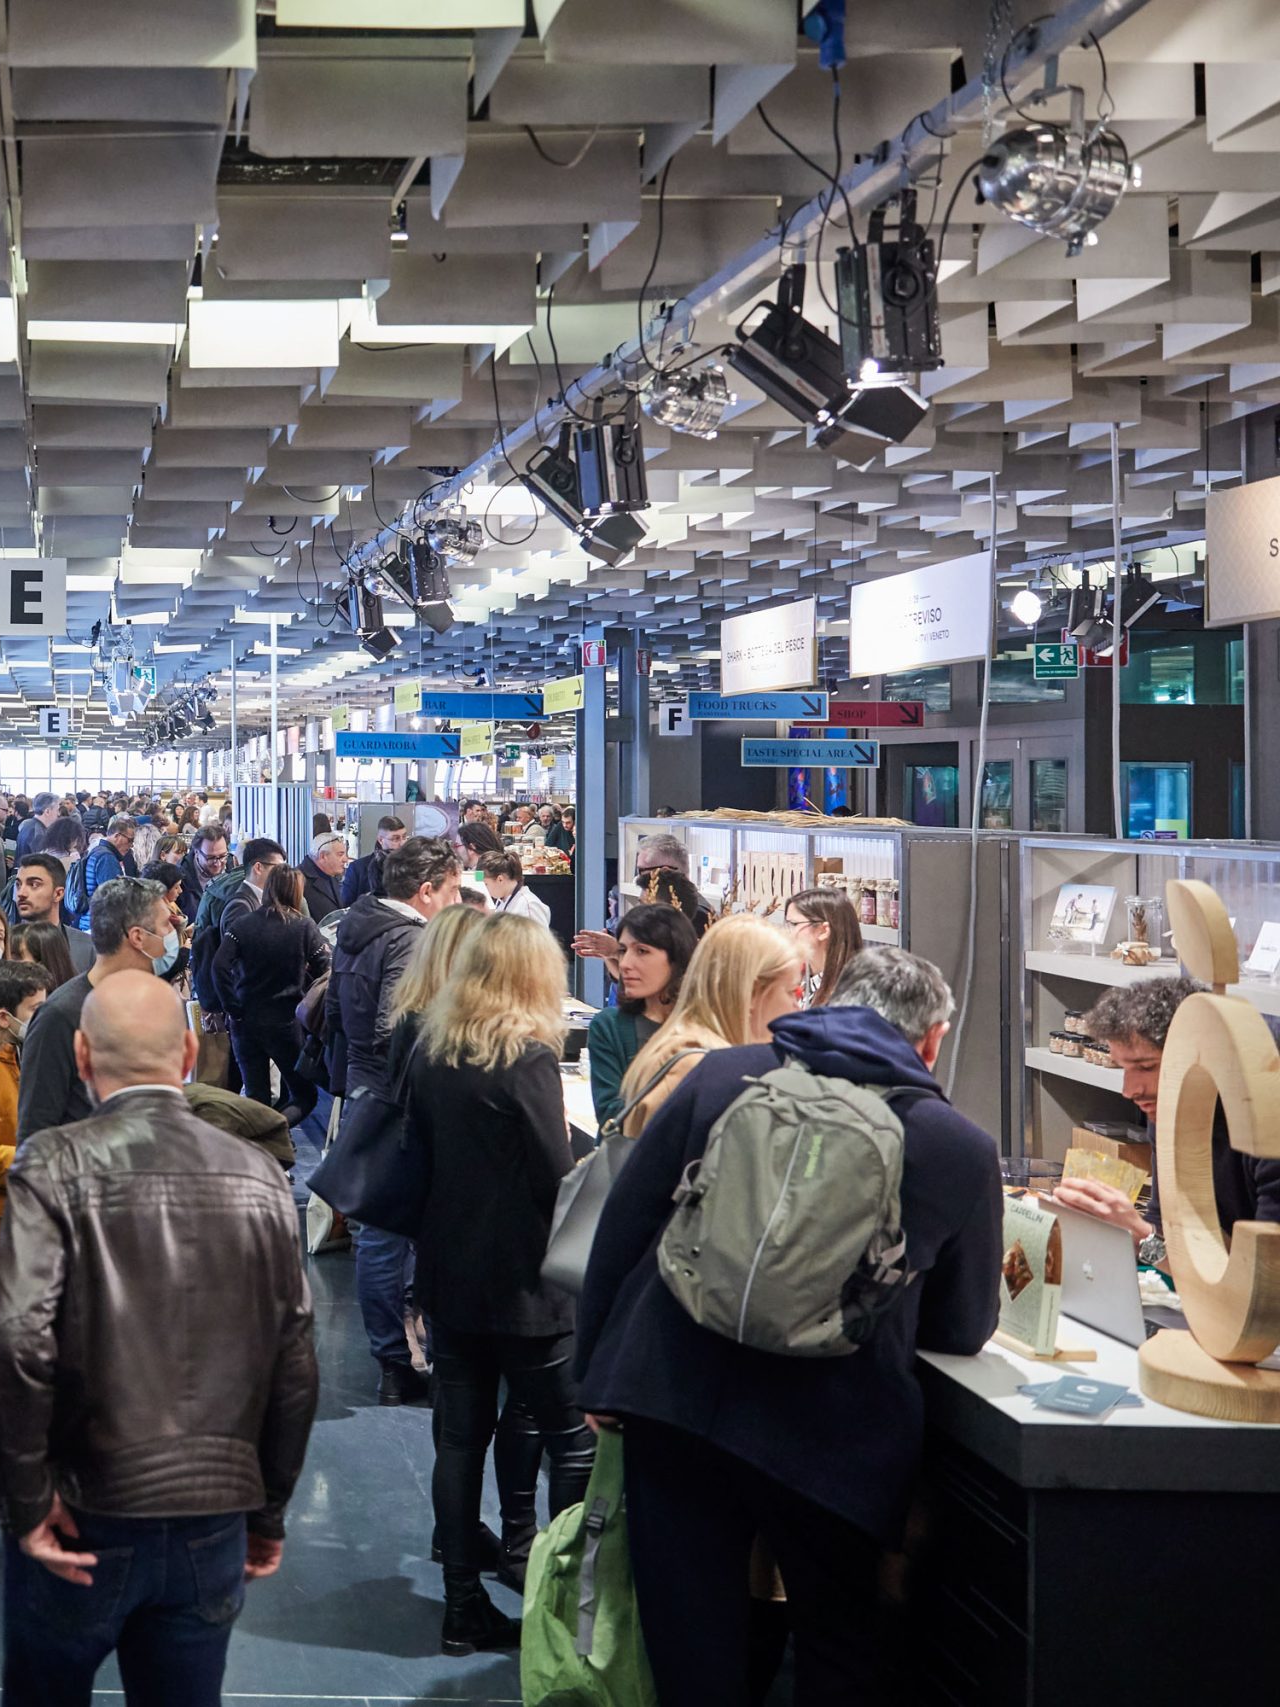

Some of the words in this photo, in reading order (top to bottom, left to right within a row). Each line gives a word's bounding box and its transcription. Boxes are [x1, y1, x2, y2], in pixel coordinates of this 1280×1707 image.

[10, 570, 43, 625] E
[929, 629, 950, 641] VENETO
[785, 637, 805, 653] PESCE
[424, 700, 447, 710] BAR
[697, 700, 728, 710] FOOD
[731, 700, 777, 711] TRUCKS
[668, 708, 682, 731] F
[837, 709, 866, 719] SHOP
[47, 712, 60, 733] E
[343, 739, 417, 751] GUARDAROBA
[747, 747, 778, 757] TASTE
[780, 748, 824, 758] SPECIAL
[826, 748, 854, 758] AREA
